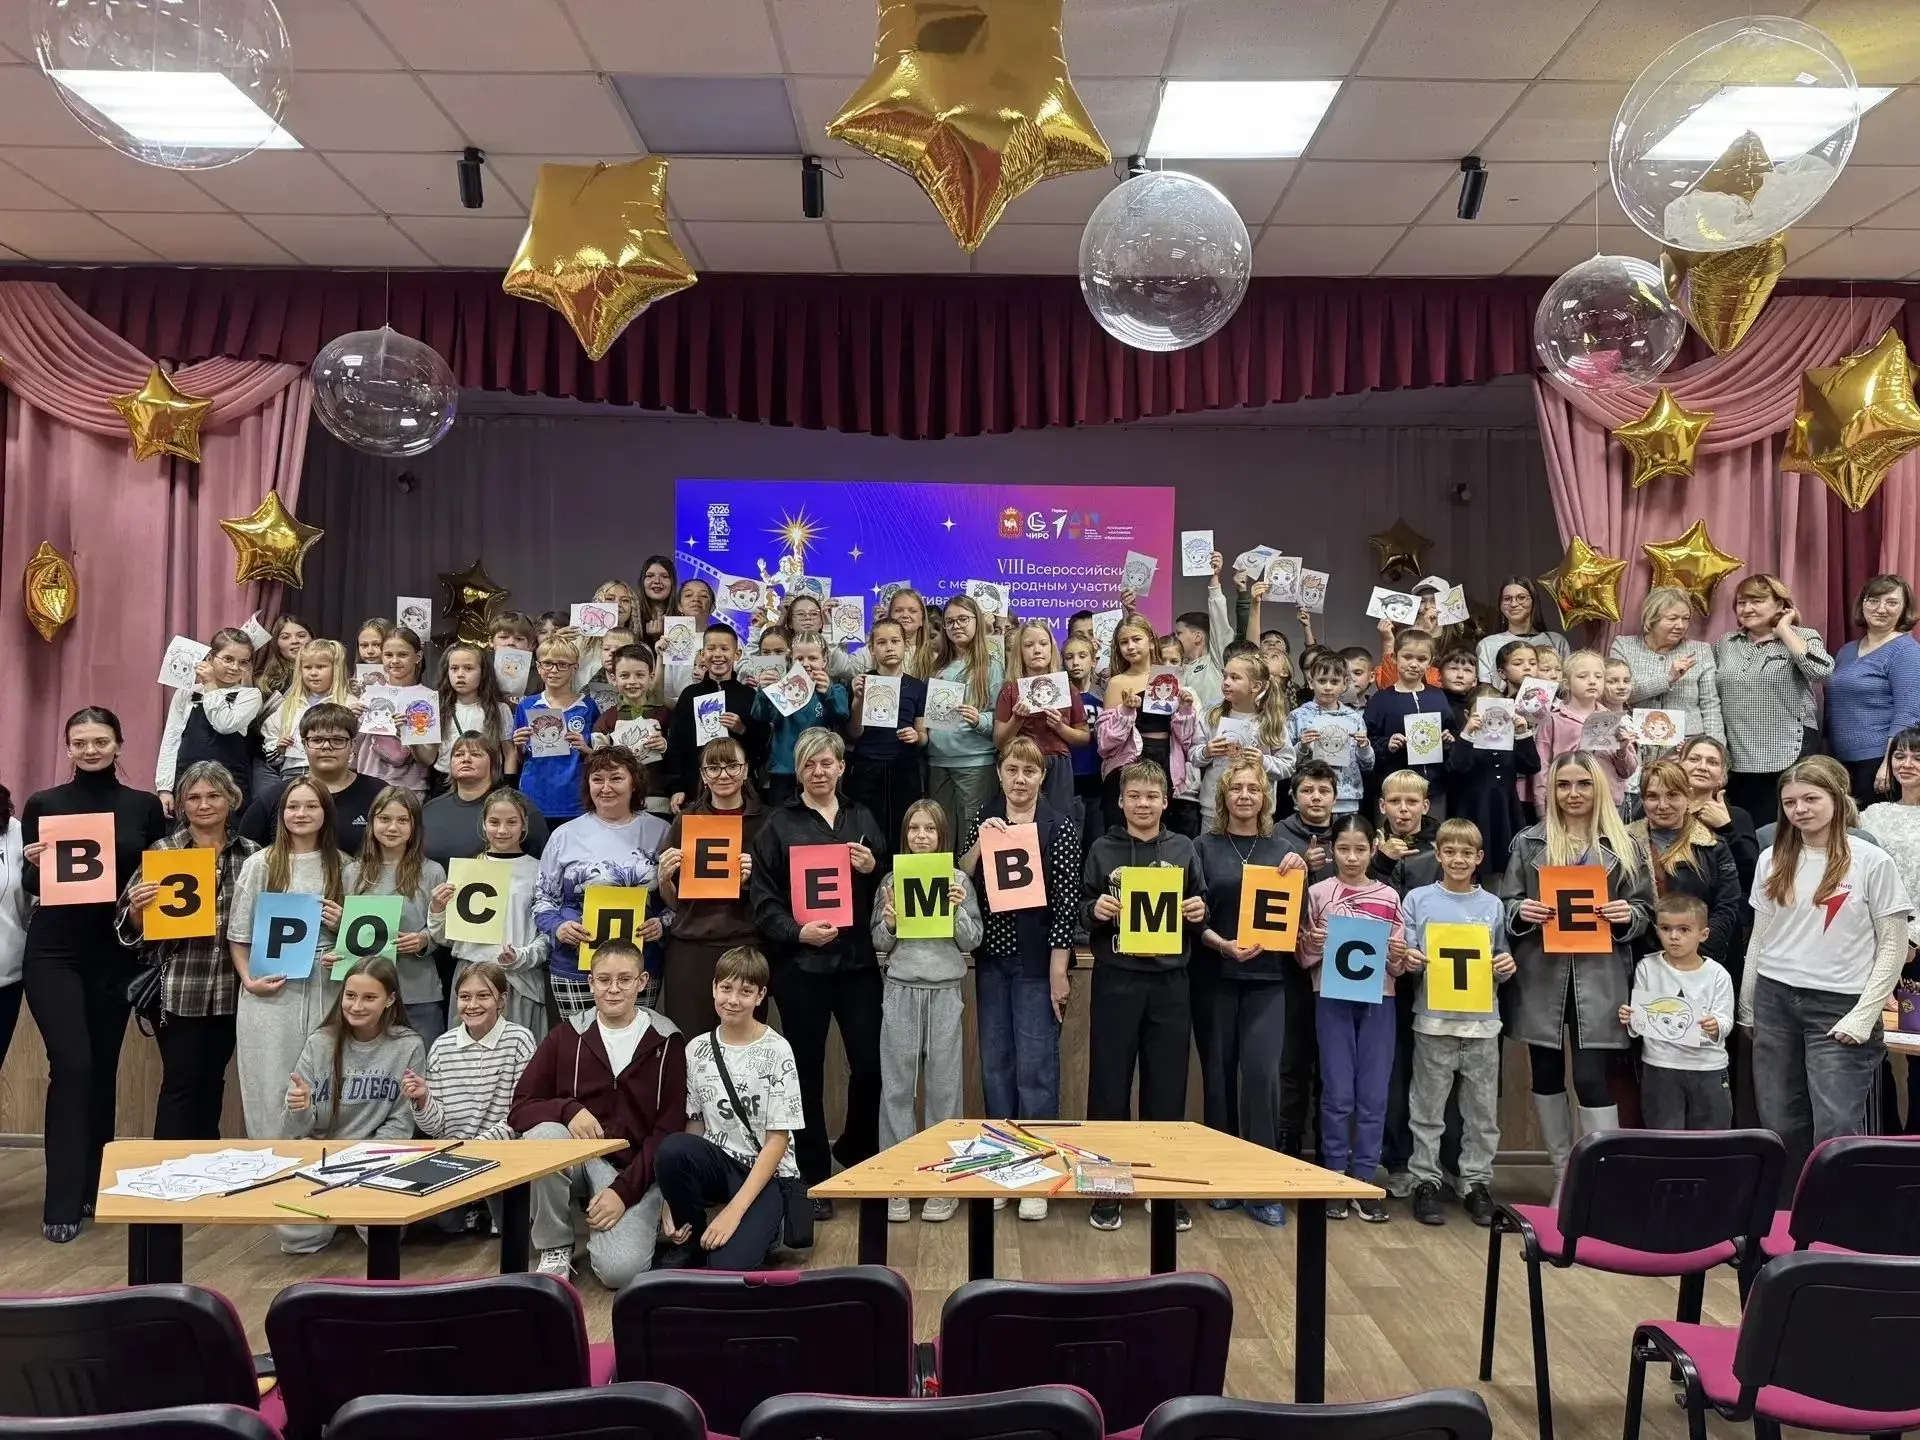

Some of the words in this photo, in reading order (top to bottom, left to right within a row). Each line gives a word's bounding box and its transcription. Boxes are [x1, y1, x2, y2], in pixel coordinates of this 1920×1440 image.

[709, 505, 730, 514] 2026
[1026, 532, 1049, 540] ЧИРО
[938, 580, 946, 589] с
[949, 580, 1067, 593] меародным
[1070, 582, 1122, 593] участи
[997, 558, 1024, 575] VIII
[1027, 563, 1124, 577] Всероссийски
[1008, 598, 1099, 608] овательного
[1102, 599, 1123, 609] ки
[56, 840, 104, 883] В
[694, 838, 730, 879] Е
[994, 848, 1034, 890] В
[456, 882, 498, 925] С
[805, 868, 841, 910] Е
[903, 877, 950, 918] М
[1130, 891, 1178, 933] М
[1253, 889, 1289, 932] Е
[1555, 889, 1598, 932] Е
[266, 917, 308, 959] Р
[345, 915, 389, 957] О
[1334, 940, 1377, 981] С
[1439, 948, 1481, 991] Т
[348, 1077, 400, 1101] DIEGO
[716, 1094, 760, 1119] SRF
